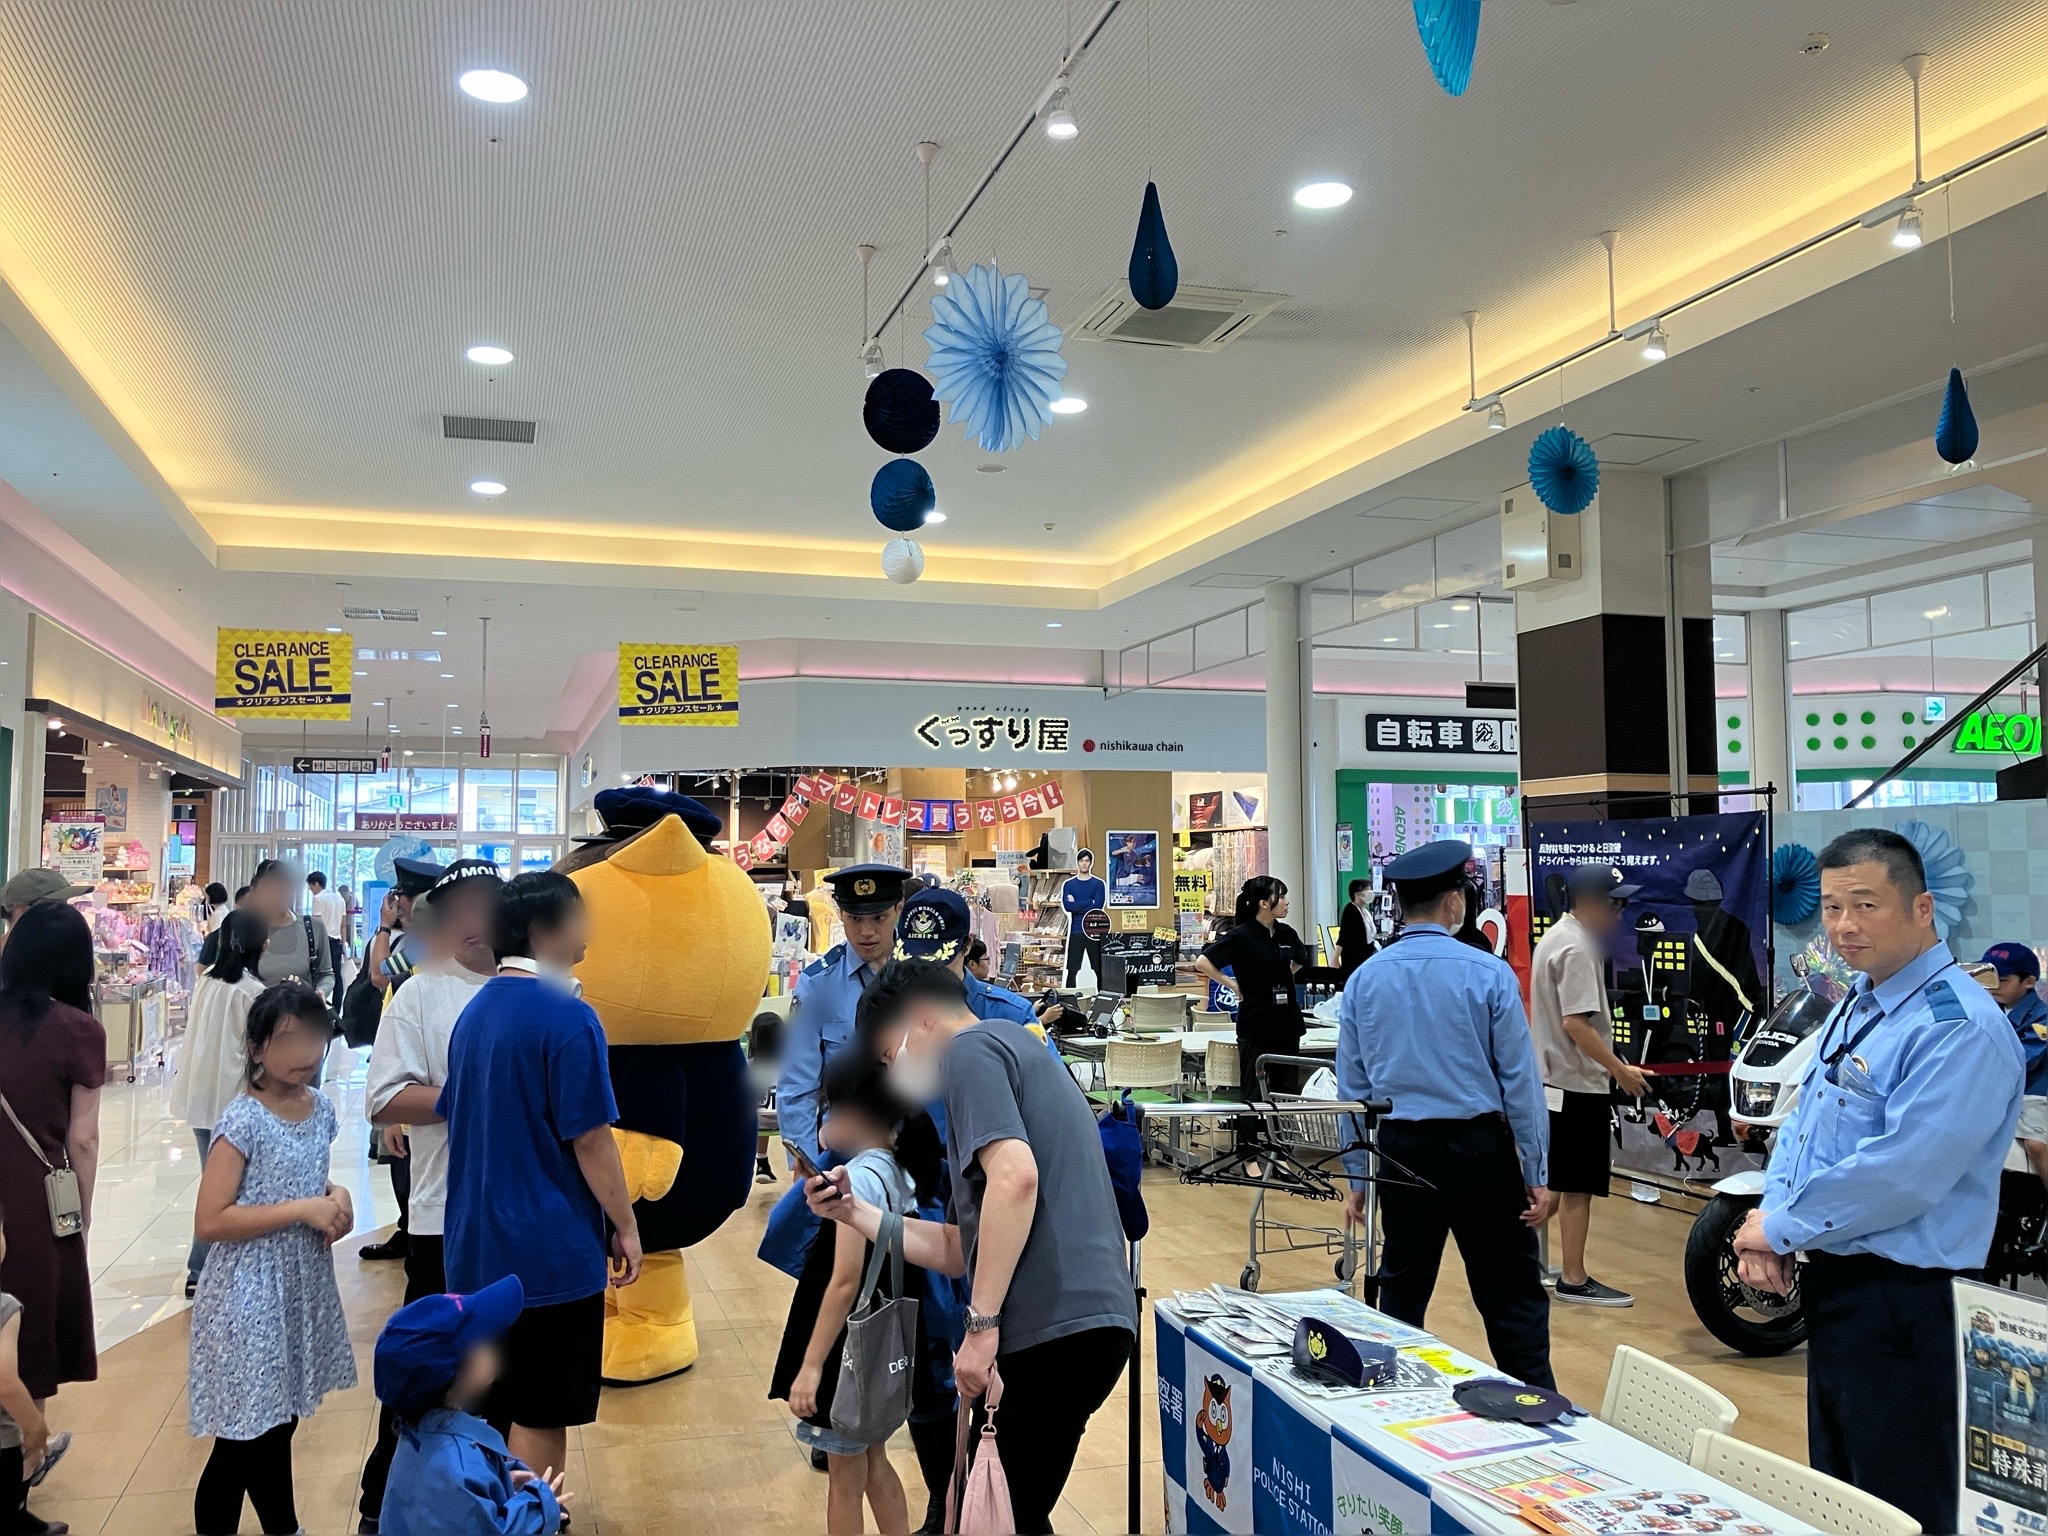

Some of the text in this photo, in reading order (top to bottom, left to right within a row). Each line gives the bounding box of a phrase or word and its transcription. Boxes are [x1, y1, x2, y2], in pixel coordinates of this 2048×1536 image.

[234, 641, 330, 658] CLEARANCE
[634, 653, 718, 670] CLEARANCE
[235, 657, 333, 695] SALE
[636, 668, 722, 704] SALE
[245, 695, 324, 707] クリアランスセール
[646, 703, 716, 715] クリアランスセール
[916, 715, 1069, 752] ぐっすり屋
[1376, 718, 1464, 749] 自転車
[1100, 741, 1184, 752] nishikawa chain
[1175, 875, 1207, 892] 無料
[1253, 1467, 1287, 1509] POLICE
[1272, 1457, 1311, 1506] NISHI
